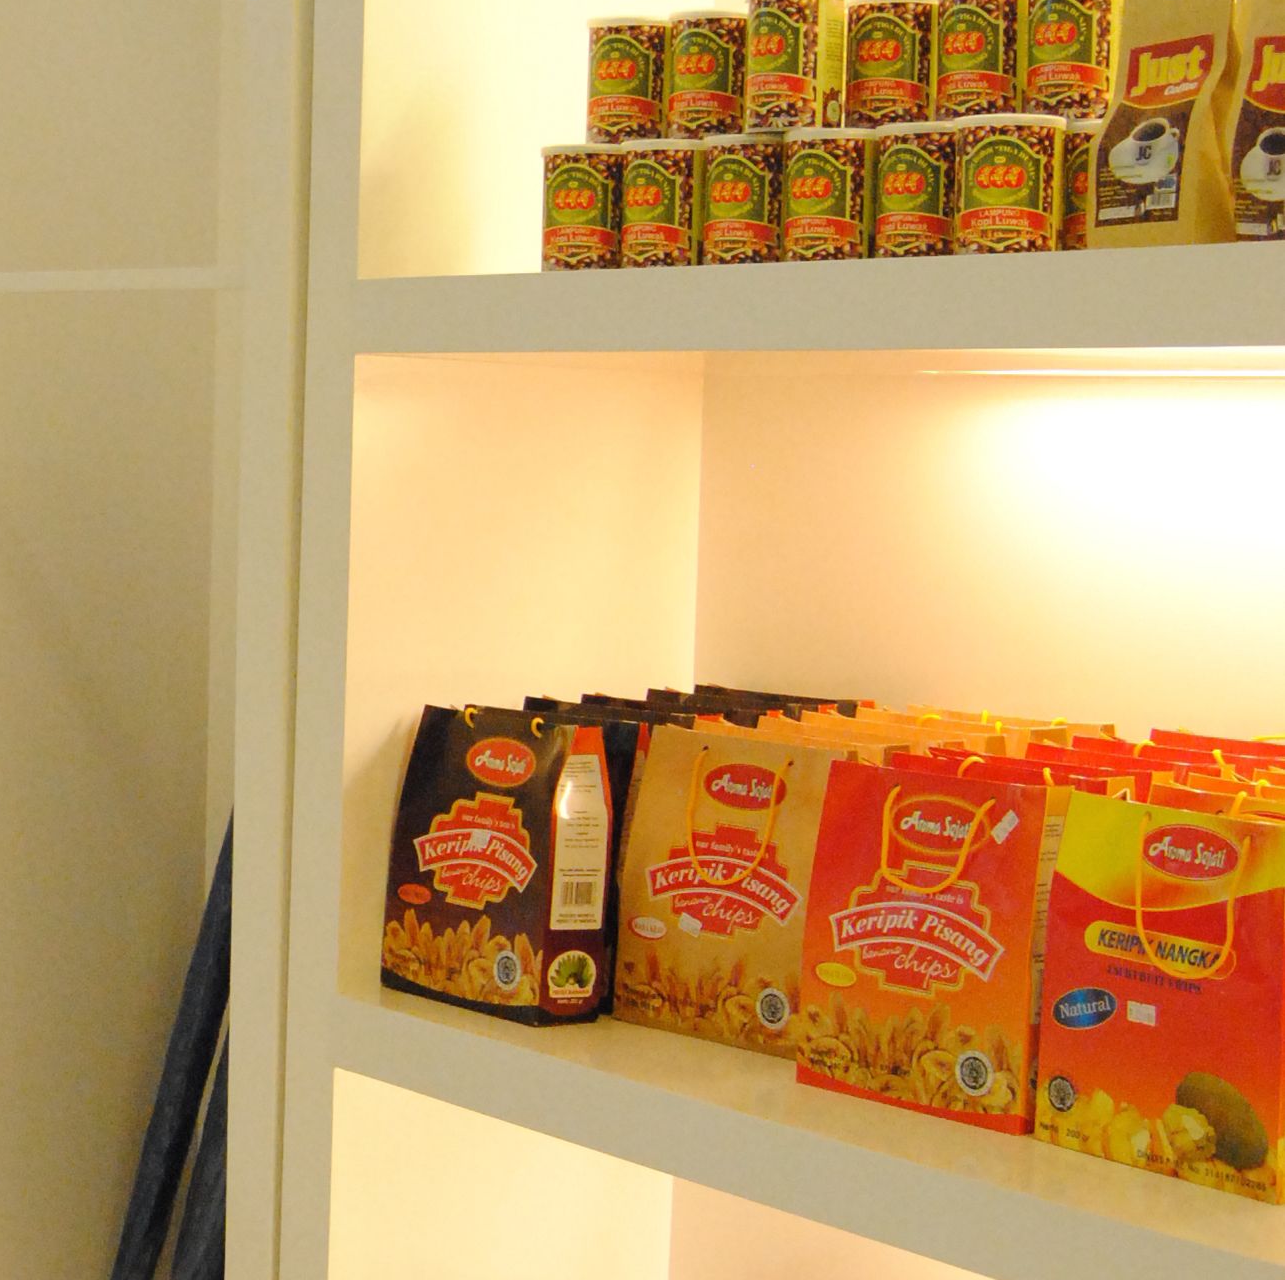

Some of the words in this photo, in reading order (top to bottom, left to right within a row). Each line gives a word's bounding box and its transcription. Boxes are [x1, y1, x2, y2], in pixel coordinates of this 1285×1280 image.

[1129, 45, 1205, 97] Just
[1251, 45, 1285, 92] Ju
[995, 217, 1030, 228] Luwak
[424, 835, 483, 861] Kerip
[486, 838, 529, 881] Pisang
[461, 865, 502, 902] chips
[702, 895, 760, 934] chips
[840, 909, 919, 939] Keripik
[920, 913, 990, 967] Pisang
[1097, 927, 1155, 956] KERIP
[893, 946, 958, 988] chips
[1059, 995, 1111, 1019] Natural
